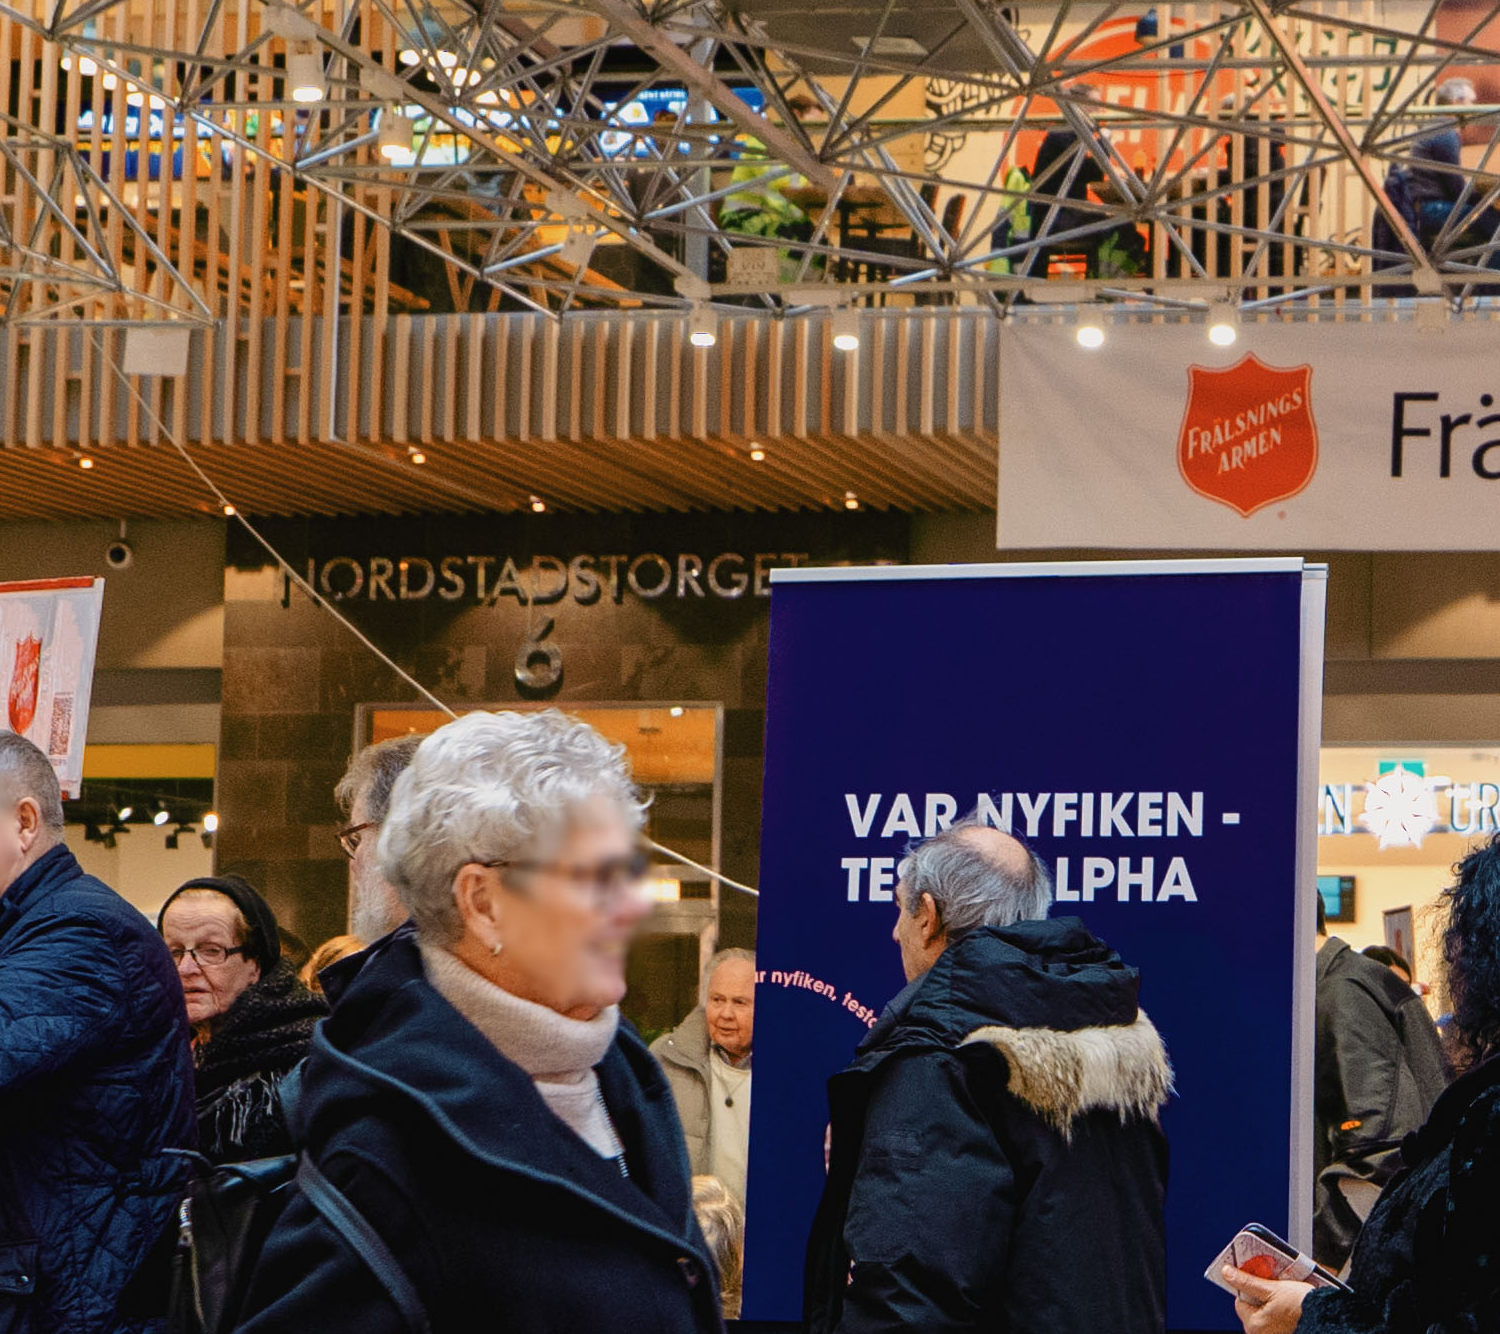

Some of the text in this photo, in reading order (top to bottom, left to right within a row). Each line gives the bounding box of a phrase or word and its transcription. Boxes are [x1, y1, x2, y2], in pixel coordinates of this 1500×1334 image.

[1187, 387, 1303, 460] FRÄLSNINGS
[514, 615, 563, 689] 6
[844, 793, 958, 838] VAR
[976, 791, 1204, 837] NYFIKEN
[1055, 857, 1198, 902] LPHA
[770, 970, 837, 1002] nyfiken,
